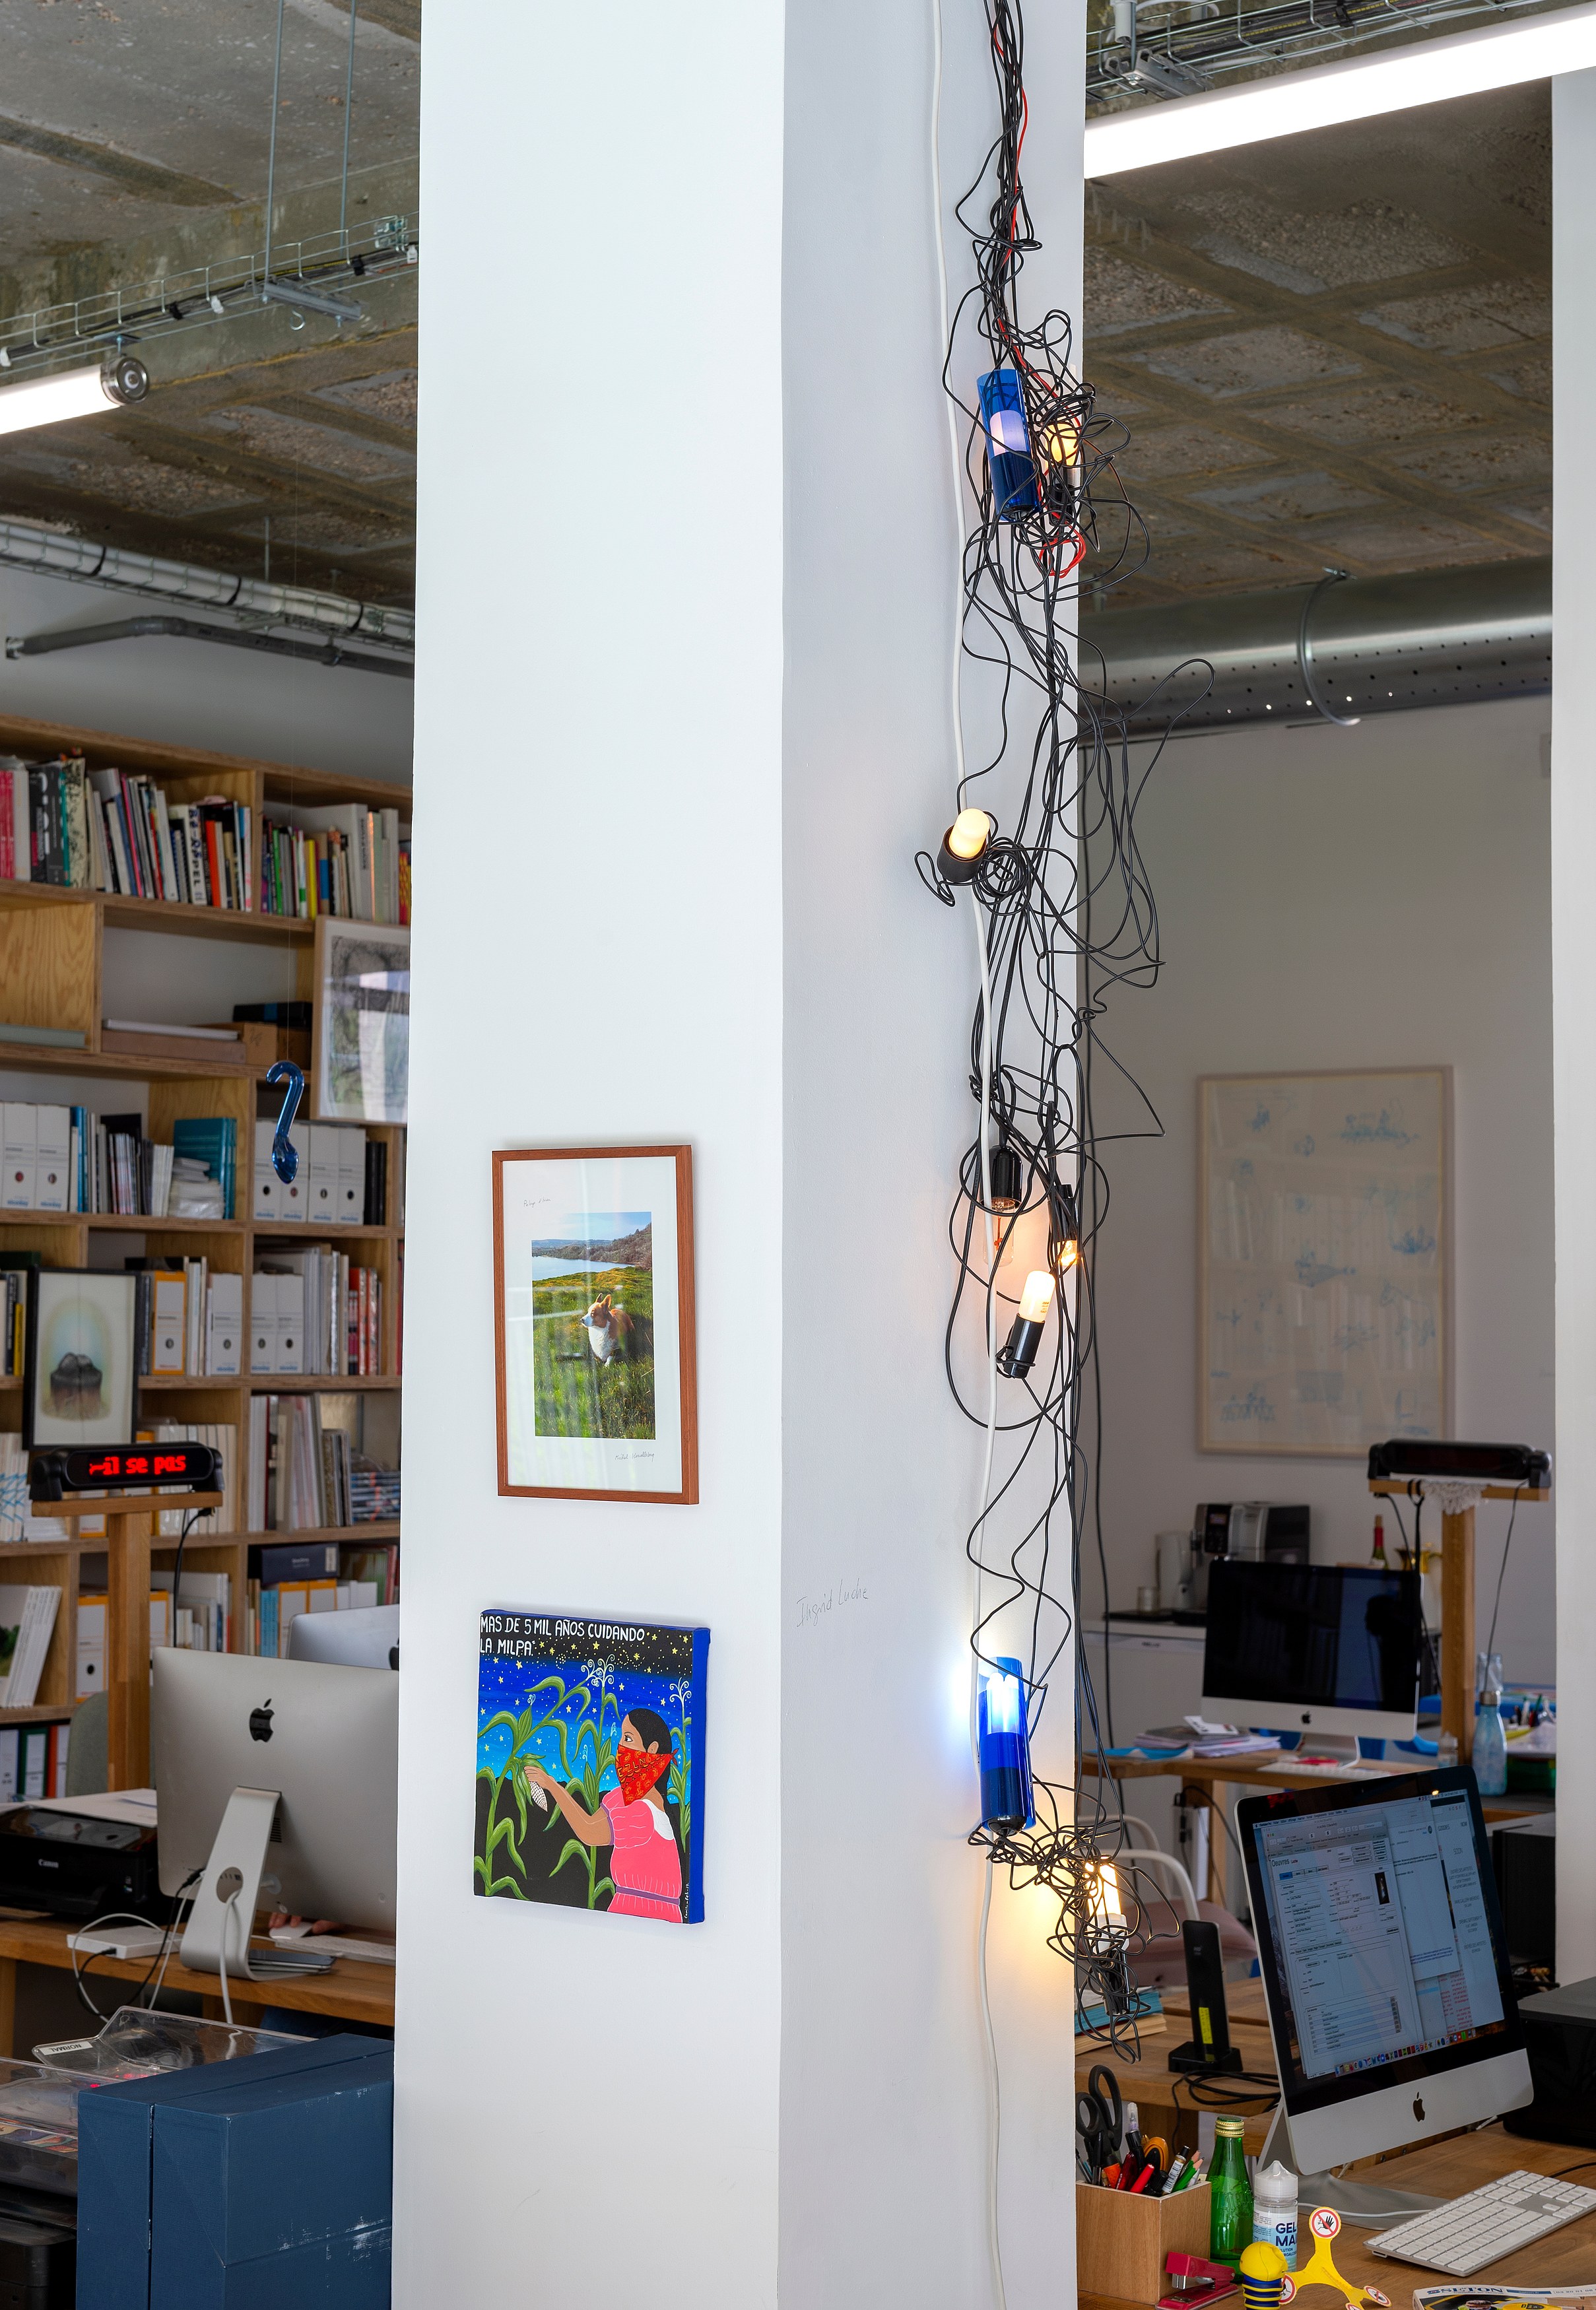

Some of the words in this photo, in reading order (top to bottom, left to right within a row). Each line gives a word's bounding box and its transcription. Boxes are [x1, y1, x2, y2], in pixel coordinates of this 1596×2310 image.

[125, 1457, 148, 1474] se
[154, 1455, 186, 1475] pas
[505, 1618, 521, 1633] DE
[525, 1619, 531, 1635] 5
[534, 1620, 552, 1635] MIL
[555, 1618, 585, 1637] AÑOS
[588, 1623, 645, 1641] CUIDANDO
[480, 1638, 492, 1653] LA
[38, 1859, 59, 1868] Canon
[1275, 2222, 1297, 2234] GEL
